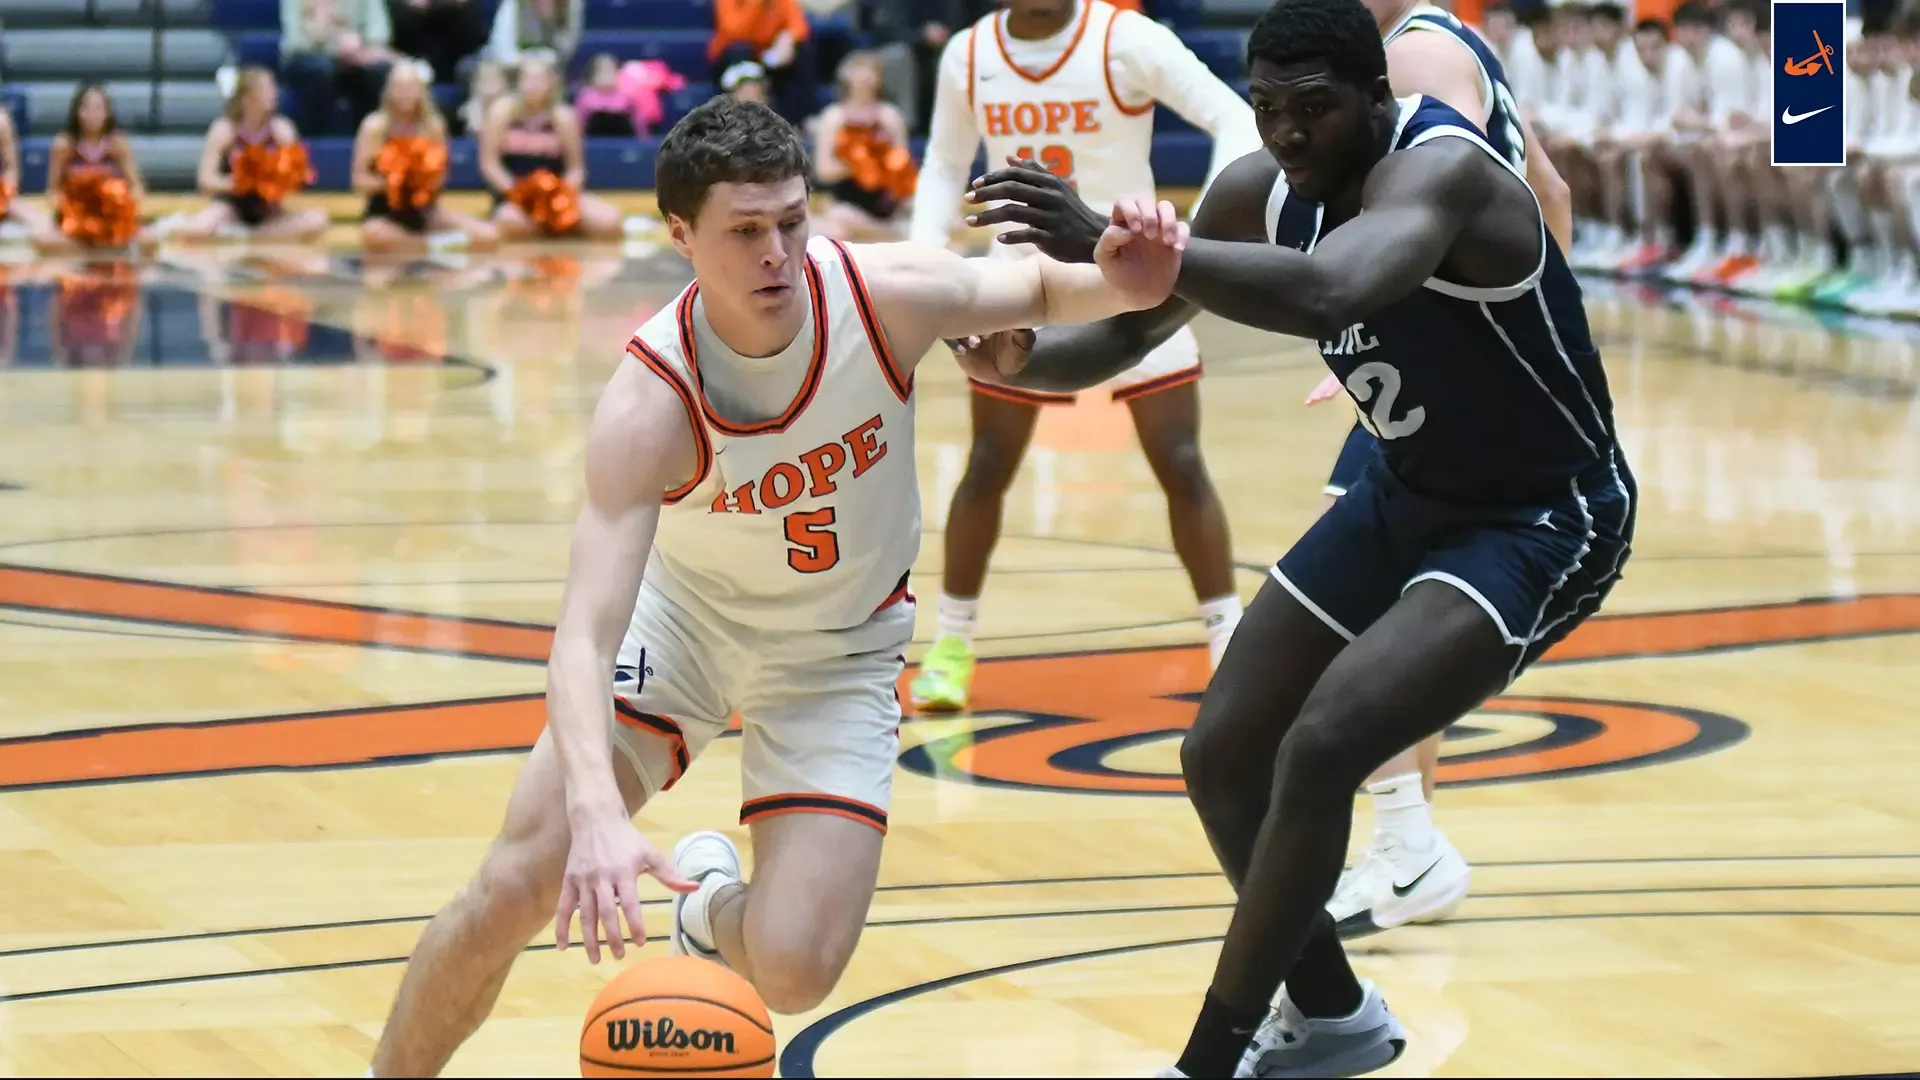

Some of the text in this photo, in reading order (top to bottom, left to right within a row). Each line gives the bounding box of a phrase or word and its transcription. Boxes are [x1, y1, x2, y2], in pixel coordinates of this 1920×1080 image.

[983, 100, 1102, 136] HOPE
[1015, 145, 1078, 191] 2
[708, 413, 888, 514] HOPE
[783, 506, 840, 574] 5
[606, 1017, 736, 1054] Wilson
